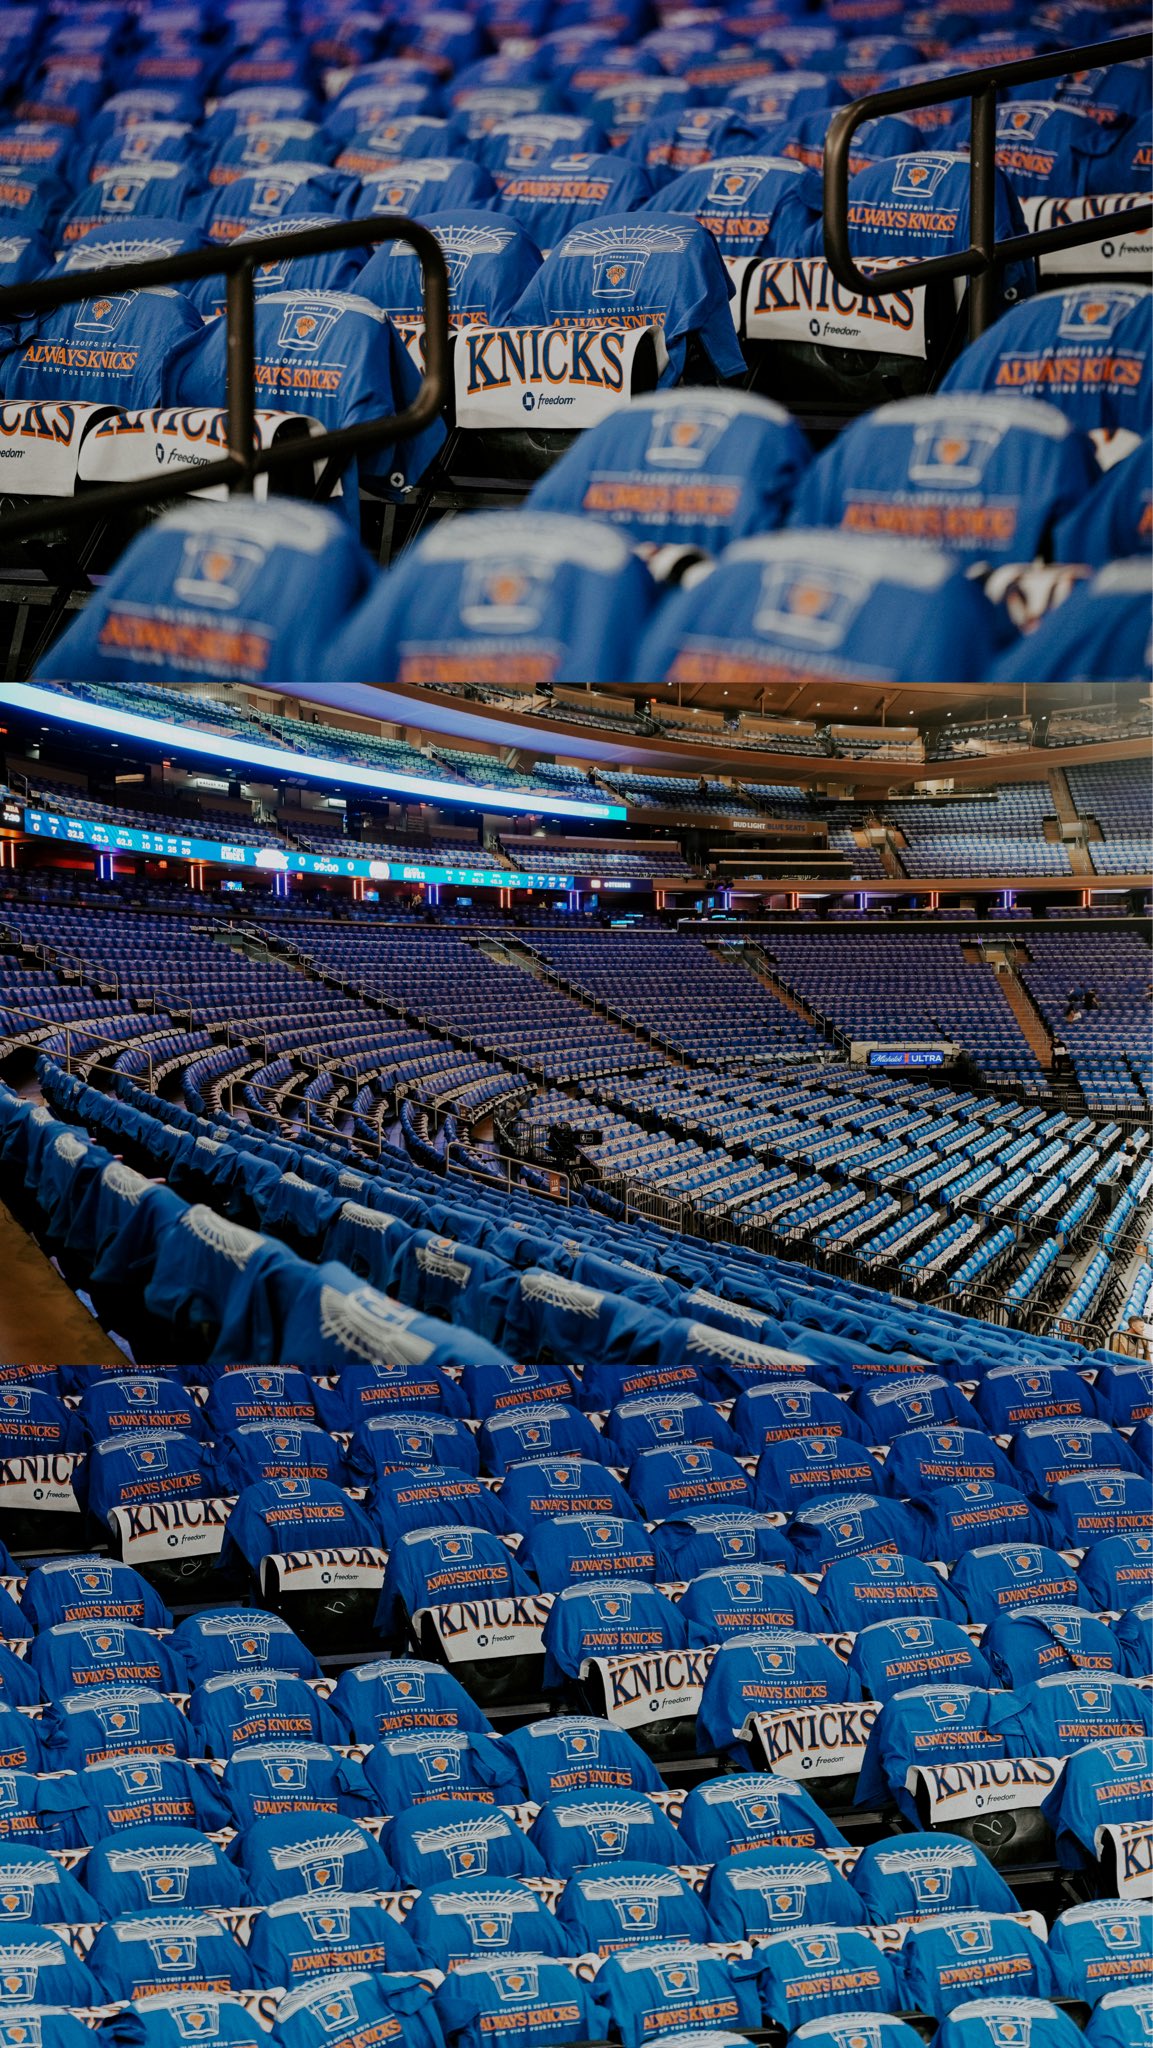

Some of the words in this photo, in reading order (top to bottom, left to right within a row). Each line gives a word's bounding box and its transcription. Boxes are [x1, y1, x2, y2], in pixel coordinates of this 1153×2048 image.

[847, 207, 907, 229] ALWAYS
[907, 212, 958, 232] KNICKS
[883, 229, 904, 237] YORK
[587, 307, 626, 315] PLAYOFFS
[621, 313, 667, 329] KNICKS
[823, 322, 860, 337] freedom
[22, 345, 87, 367] ALWAYS
[86, 349, 139, 370] KNICKS
[466, 329, 625, 395] KNICKS
[292, 368, 343, 390] KNICKS
[537, 393, 574, 409] freedom
[167, 449, 209, 466] freedom
[33, 823, 40, 832] 0
[51, 826, 57, 835] 7
[733, 821, 747, 829] BUD
[747, 822, 767, 830] LIGHT
[67, 829, 84, 840] 32.5
[298, 856, 306, 866] 0
[313, 862, 339, 873] 99:00
[347, 861, 354, 871] 0
[911, 1054, 942, 1062] ULTRA
[624, 1376, 657, 1391] ALWAYS
[659, 1369, 695, 1383] KNICKS
[362, 1388, 398, 1400] ALWAYS
[400, 1385, 439, 1396] KNICKS
[496, 1393, 530, 1407] ALWAYS
[533, 1385, 571, 1400] KNICKS
[237, 1406, 272, 1416] ALWAYS
[275, 1406, 314, 1416] KNICKS
[1010, 1408, 1043, 1420] ALWAYS
[110, 1415, 146, 1425] ALWAYS
[150, 1414, 190, 1425] KNICKS
[767, 1429, 804, 1440] ALWAYS
[804, 1426, 842, 1436] KNICKS
[0, 1455, 83, 1487] KNIC
[791, 1472, 830, 1482] ALWAYS
[831, 1467, 871, 1479] KNICKS
[122, 1483, 160, 1497] ALWAYS
[161, 1474, 200, 1490] KNICKS
[670, 1485, 706, 1498] ALWAYS
[707, 1479, 746, 1493] KNICKS
[46, 1490, 70, 1500] freedom
[398, 1488, 439, 1501] ALWAYS
[440, 1484, 480, 1495] KNICKS
[531, 1500, 568, 1510] ALWAYS
[572, 1500, 612, 1510] KNICKS
[267, 1509, 302, 1521] AWAYS
[953, 1512, 989, 1525] ALWAYS
[989, 1505, 1027, 1519] KNICKS
[1079, 1517, 1114, 1527] ALWAYS
[1117, 1516, 1153, 1527] KNICKS
[181, 1534, 207, 1544] freedom
[573, 1560, 612, 1570] ALWAYS
[614, 1556, 654, 1568] KNICKS
[333, 1572, 359, 1583] freedom
[465, 1568, 507, 1582] KNICKS
[897, 1587, 936, 1597] KNICKS
[436, 1597, 552, 1638] KNICKS
[753, 1614, 794, 1625] KNICKS
[491, 1634, 515, 1645] freedom
[621, 1632, 662, 1644] KNICKS
[887, 1660, 927, 1674] ALWAYS
[928, 1652, 970, 1668] KNICKS
[117, 1666, 160, 1678] KNICKS
[743, 1686, 783, 1698] ALWAYS
[785, 1686, 827, 1698] KNICKS
[662, 1696, 691, 1709] freedom
[269, 1719, 311, 1730] KNICKS
[415, 1714, 457, 1726] KNICKS
[764, 1709, 878, 1765] KNICKS
[1098, 1725, 1144, 1736] KNICKS
[129, 1744, 176, 1756] KNICKS
[816, 1756, 844, 1767] freedom
[551, 1772, 587, 1787] ALWYS
[928, 1758, 1055, 1805] KNICKS
[1098, 1783, 1138, 1799] ALWAYS
[987, 1793, 1016, 1805] freedom
[154, 1803, 194, 1814] KNICK
[294, 1802, 336, 1811] KNICKS
[772, 1834, 815, 1847] KNICKS
[293, 1953, 338, 1970] ALWAYS
[338, 1948, 384, 1965] KNICKS
[941, 1967, 983, 1983] ALWAYS
[984, 1960, 1031, 1976] KNICKS
[1088, 1962, 1131, 1977] ALWAYS
[787, 1980, 830, 1997] ALWAYS
[832, 1972, 879, 1989] KNICKS
[481, 2013, 527, 2030] ALWAYS
[528, 2007, 579, 2024] KNICKS
[645, 2010, 689, 2028] ALWAYS
[689, 2002, 738, 2020] KNICKS
